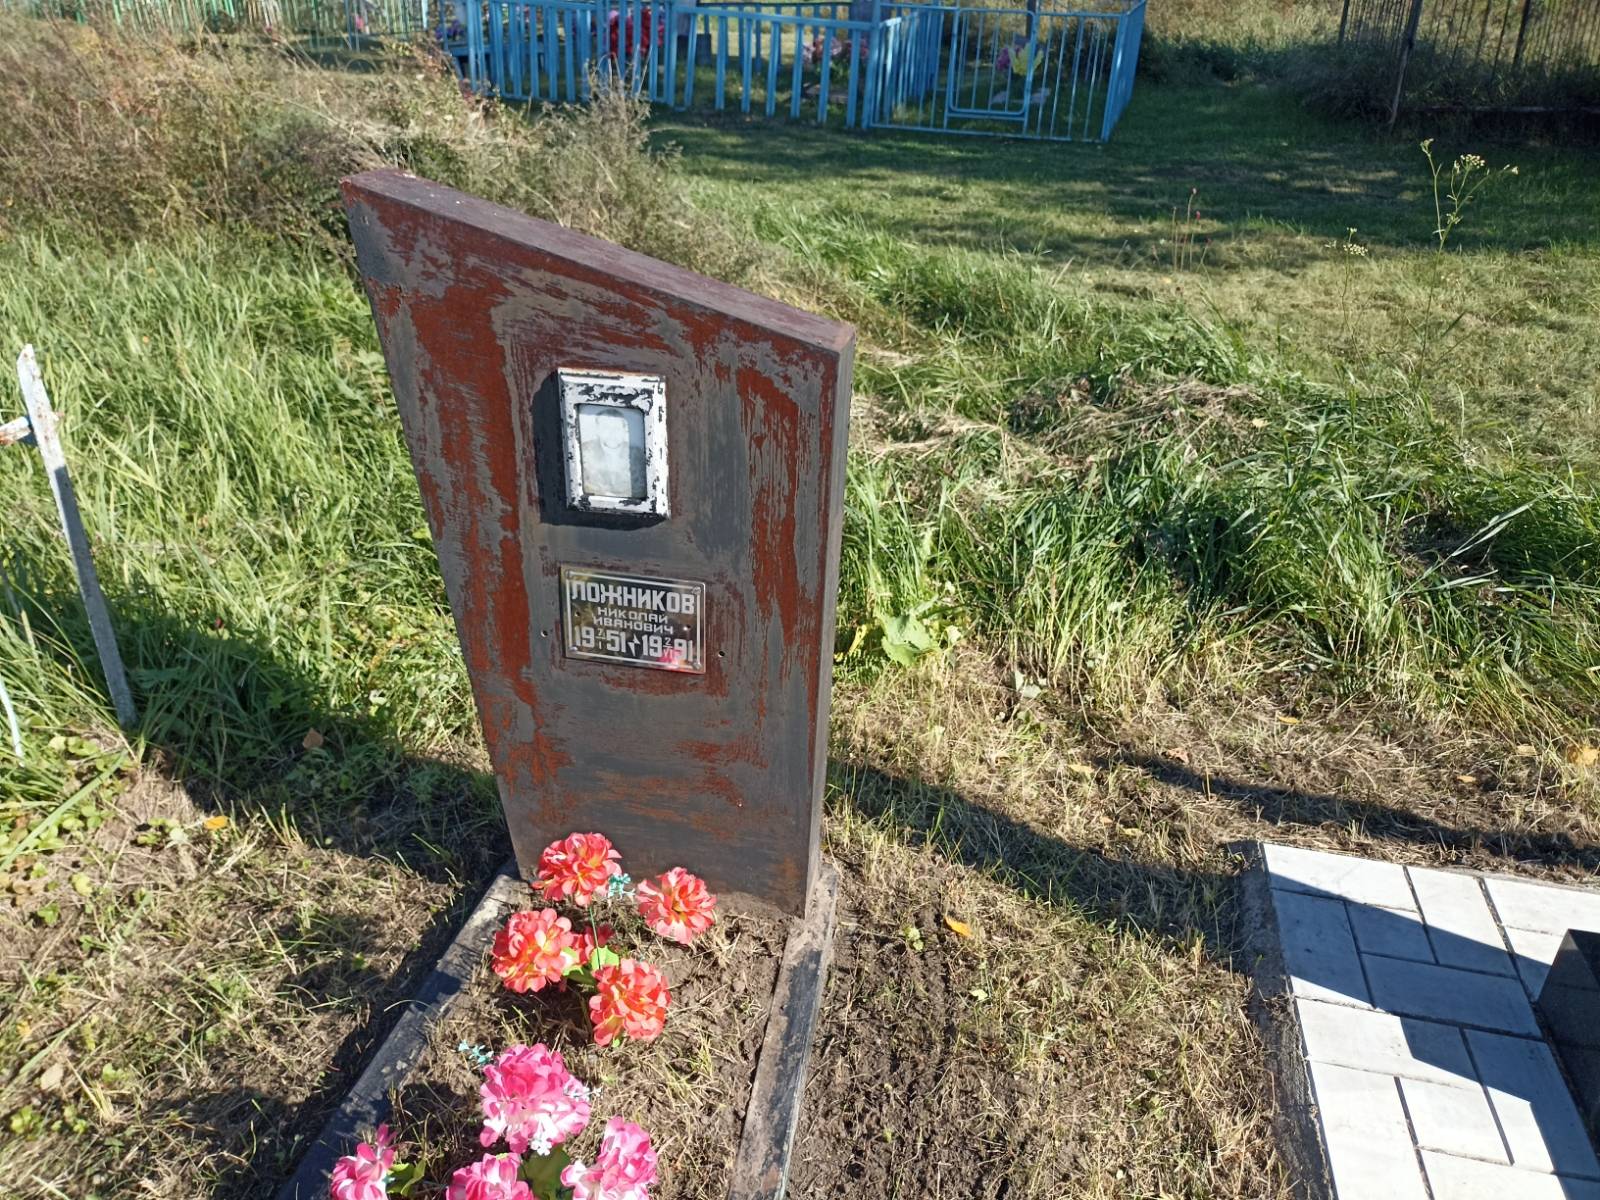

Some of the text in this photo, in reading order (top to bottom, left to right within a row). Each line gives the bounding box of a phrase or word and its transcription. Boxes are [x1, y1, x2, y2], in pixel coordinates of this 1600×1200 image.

[571, 580, 695, 615] ЛОЖНИКОВ
[597, 606, 668, 624] НИКОЛАЙ
[593, 616, 674, 635] ИВАНОВИЧ
